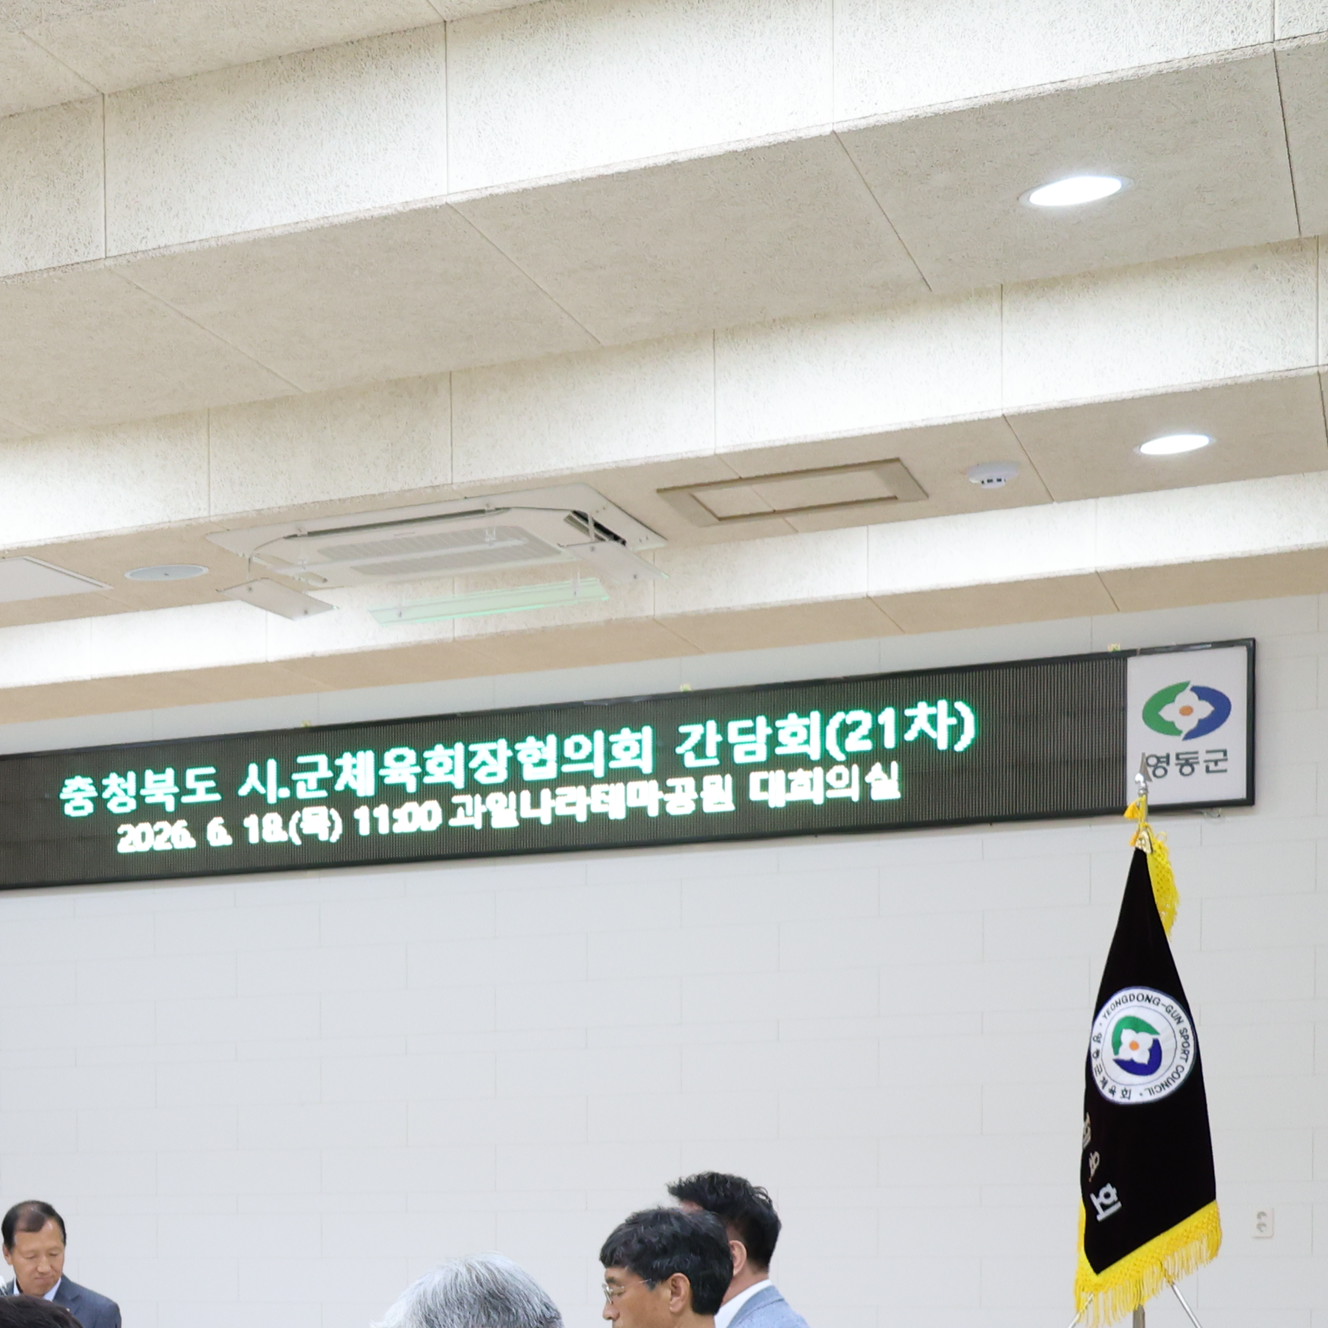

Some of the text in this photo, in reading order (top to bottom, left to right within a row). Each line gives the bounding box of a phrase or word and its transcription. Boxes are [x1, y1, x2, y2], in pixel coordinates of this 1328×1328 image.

[59, 698, 976, 818] 충청북도 시.군체육회장협의회 간담회(21차)
[1144, 748, 1229, 779] 영동군
[117, 819, 197, 853] 2026.
[353, 799, 443, 836] 11:00
[448, 774, 736, 830] 과일나라테마공원
[749, 760, 902, 809] 대회의실
[1179, 1027, 1192, 1064] SPORT
[1145, 1064, 1185, 1098] COUNCIL
